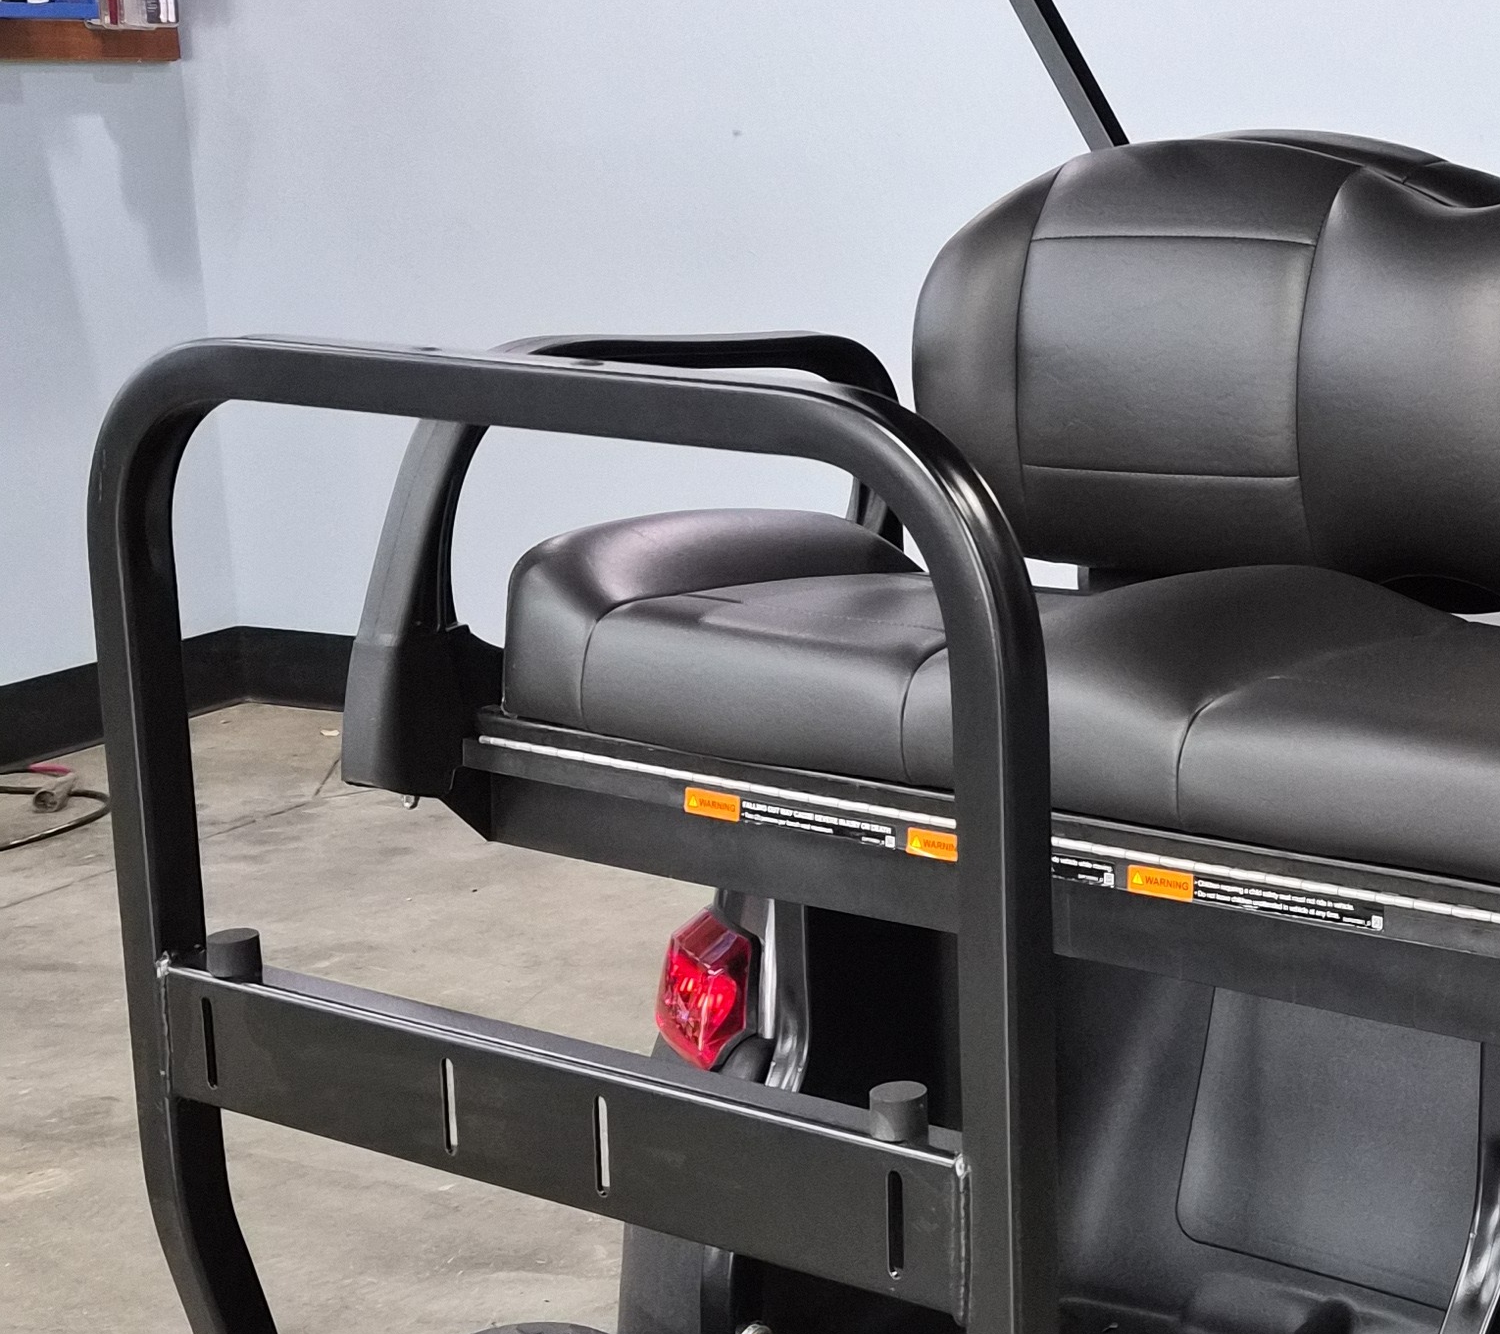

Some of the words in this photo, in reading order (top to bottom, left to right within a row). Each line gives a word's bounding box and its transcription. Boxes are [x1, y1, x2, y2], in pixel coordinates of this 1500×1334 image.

[699, 798, 736, 813] WARNING
[923, 838, 955, 852] WARNIN
[1145, 875, 1189, 891] WARNING
